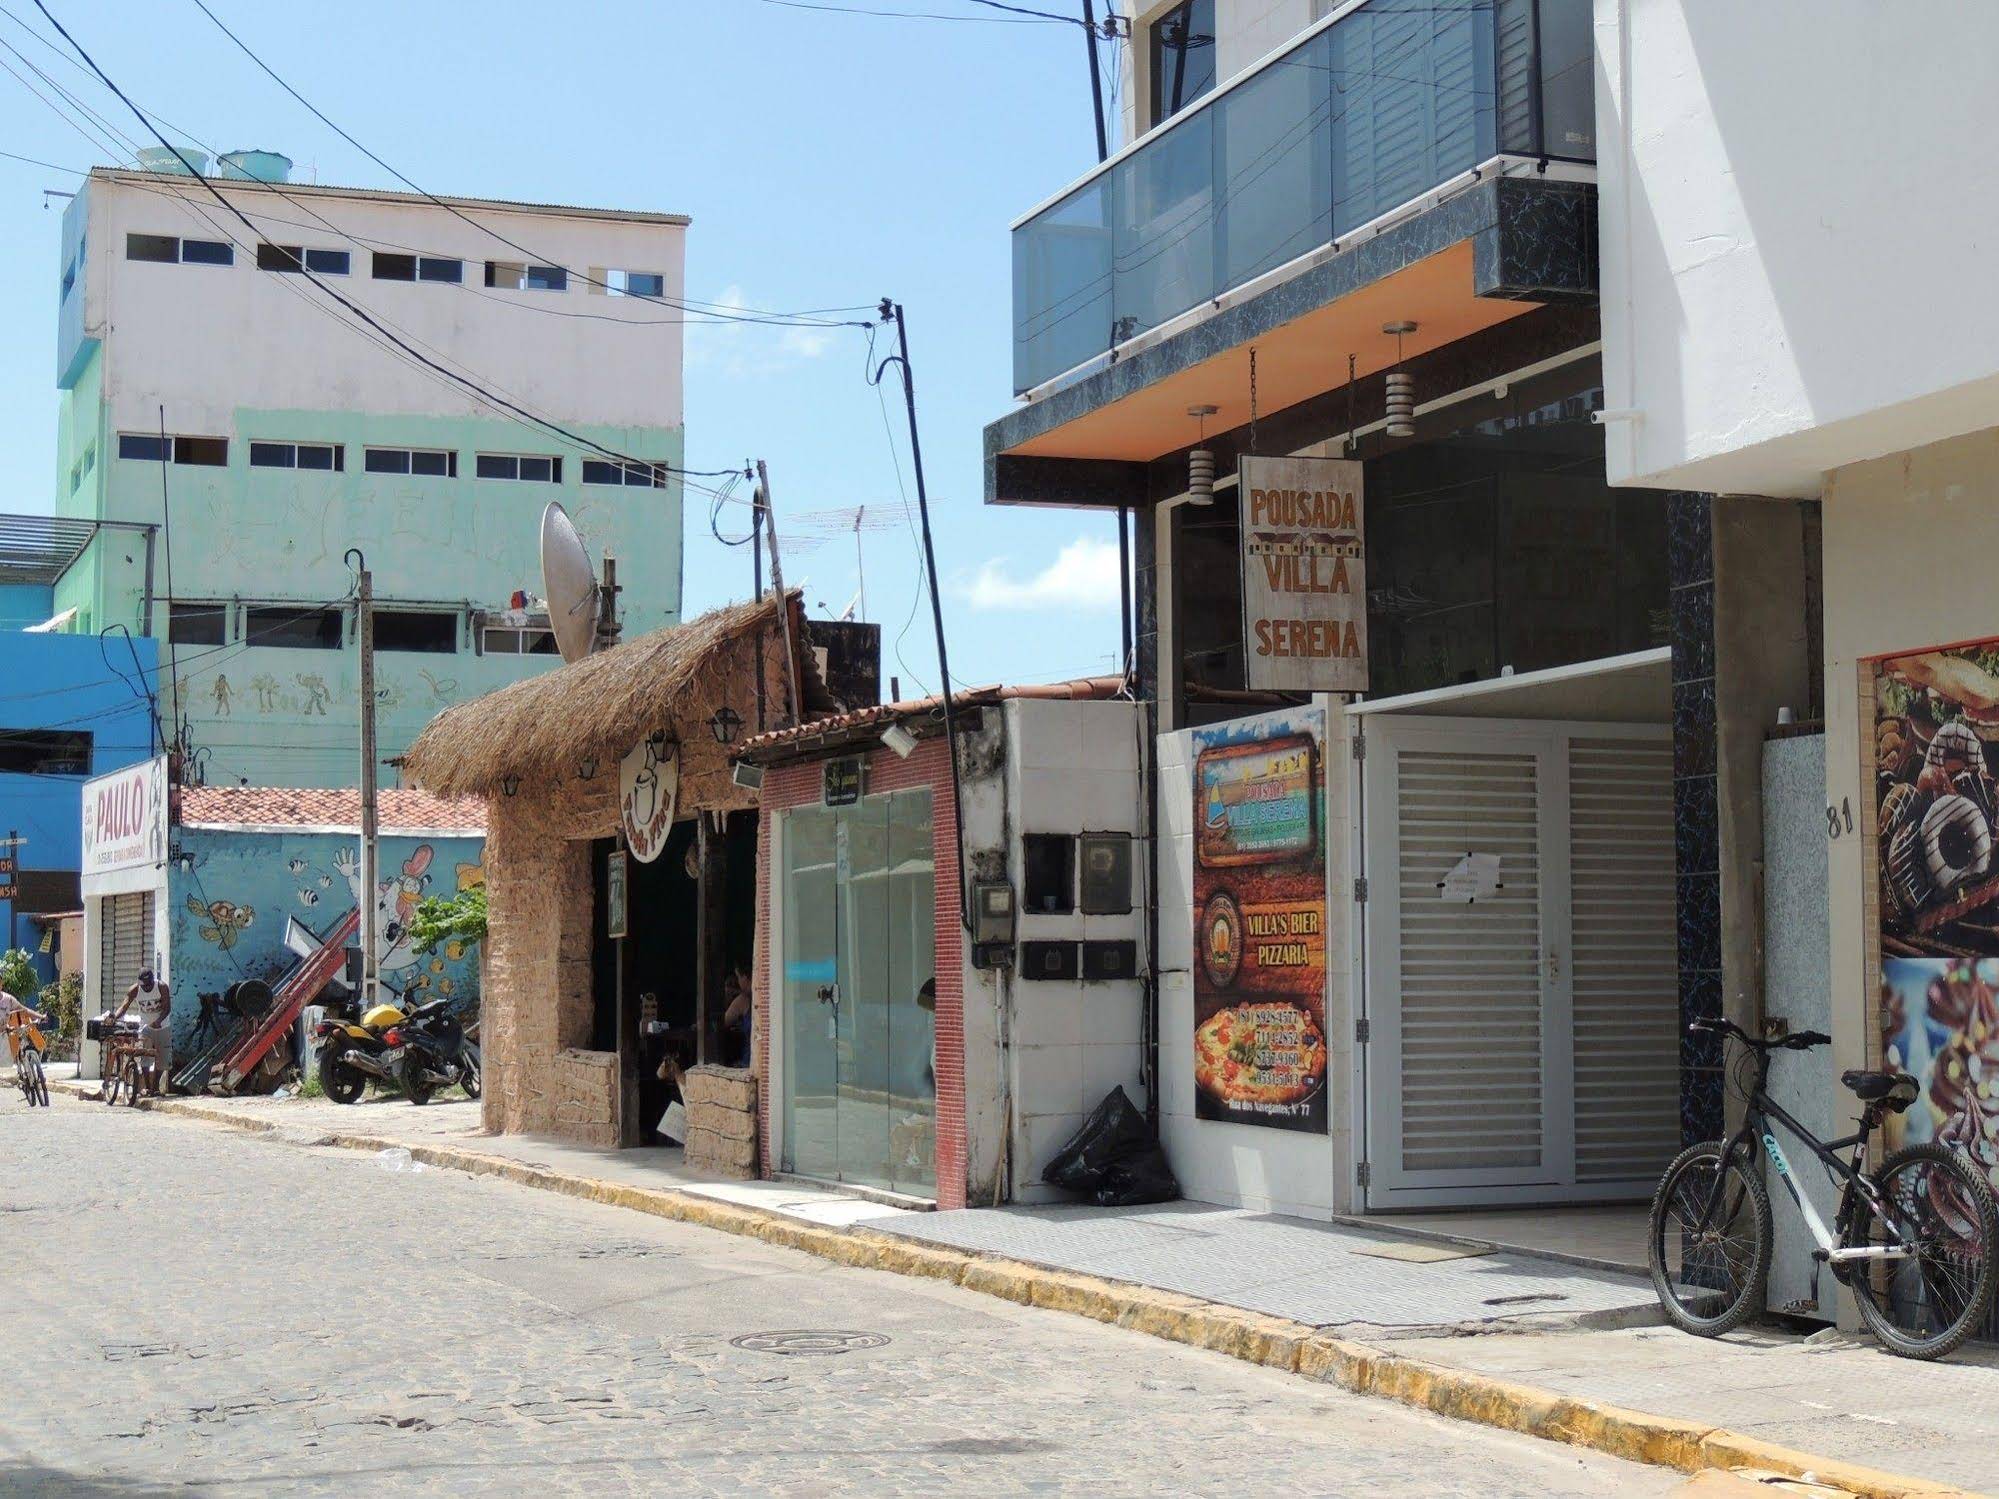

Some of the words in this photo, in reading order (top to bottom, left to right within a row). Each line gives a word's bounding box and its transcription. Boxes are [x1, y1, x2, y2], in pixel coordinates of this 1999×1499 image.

[1250, 489, 1356, 529] POUSADA
[1263, 555, 1351, 594] VILLA
[1255, 619, 1361, 658] SERENA
[96, 774, 144, 844] PAULO
[1227, 804, 1258, 826] VILLA
[1259, 797, 1307, 823] SERENA
[1826, 796, 1854, 839] 81
[1247, 914, 1288, 936] VILLA'S
[1291, 912, 1318, 934] BIER
[1258, 944, 1309, 966] PIZZARIA
[1242, 1099, 1253, 1111] dos
[1301, 1104, 1310, 1116] 77
